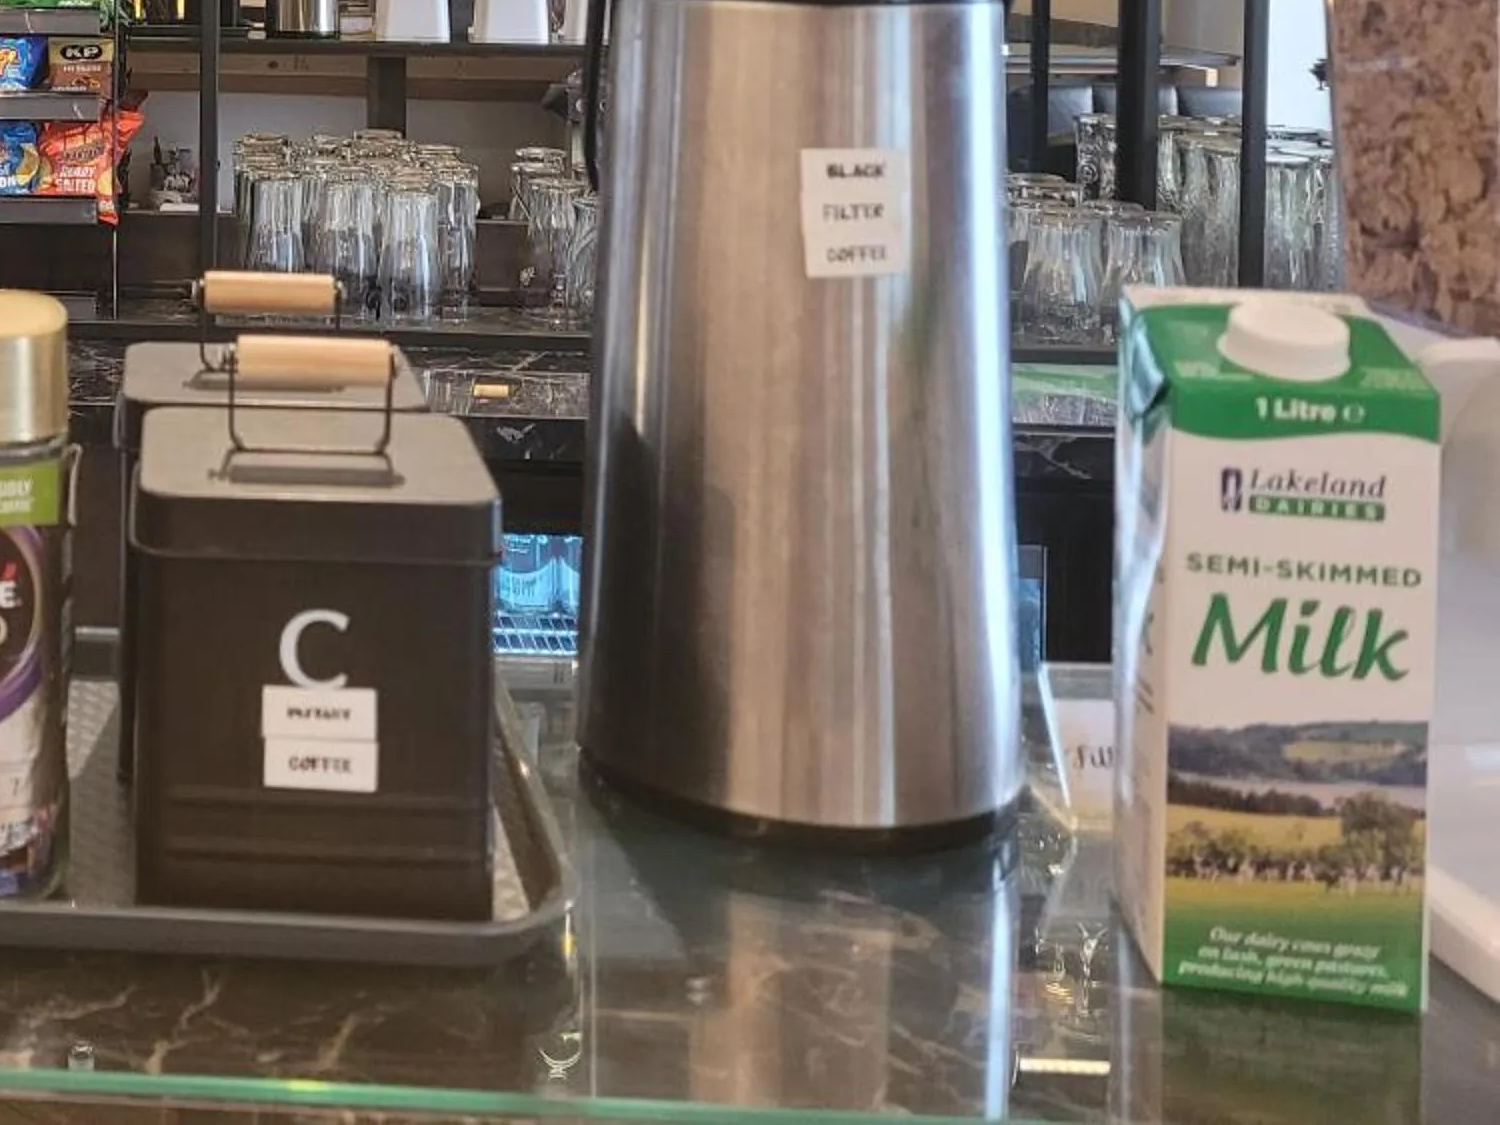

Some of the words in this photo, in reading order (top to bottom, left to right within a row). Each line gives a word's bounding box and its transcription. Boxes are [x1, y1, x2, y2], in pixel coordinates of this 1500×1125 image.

[65, 46, 99, 58] KP
[55, 177, 97, 192] SALTED
[1256, 397, 1268, 418] 1
[1273, 398, 1337, 422] Litre
[1250, 468, 1387, 500] Lakeland
[1255, 498, 1379, 520] DAIRIES
[1186, 552, 1422, 589] SEMI-SKIMMED
[279, 609, 350, 690] C
[1191, 592, 1409, 682] Milk
[1209, 925, 1243, 944] Our
[1244, 931, 1290, 953] dairy
